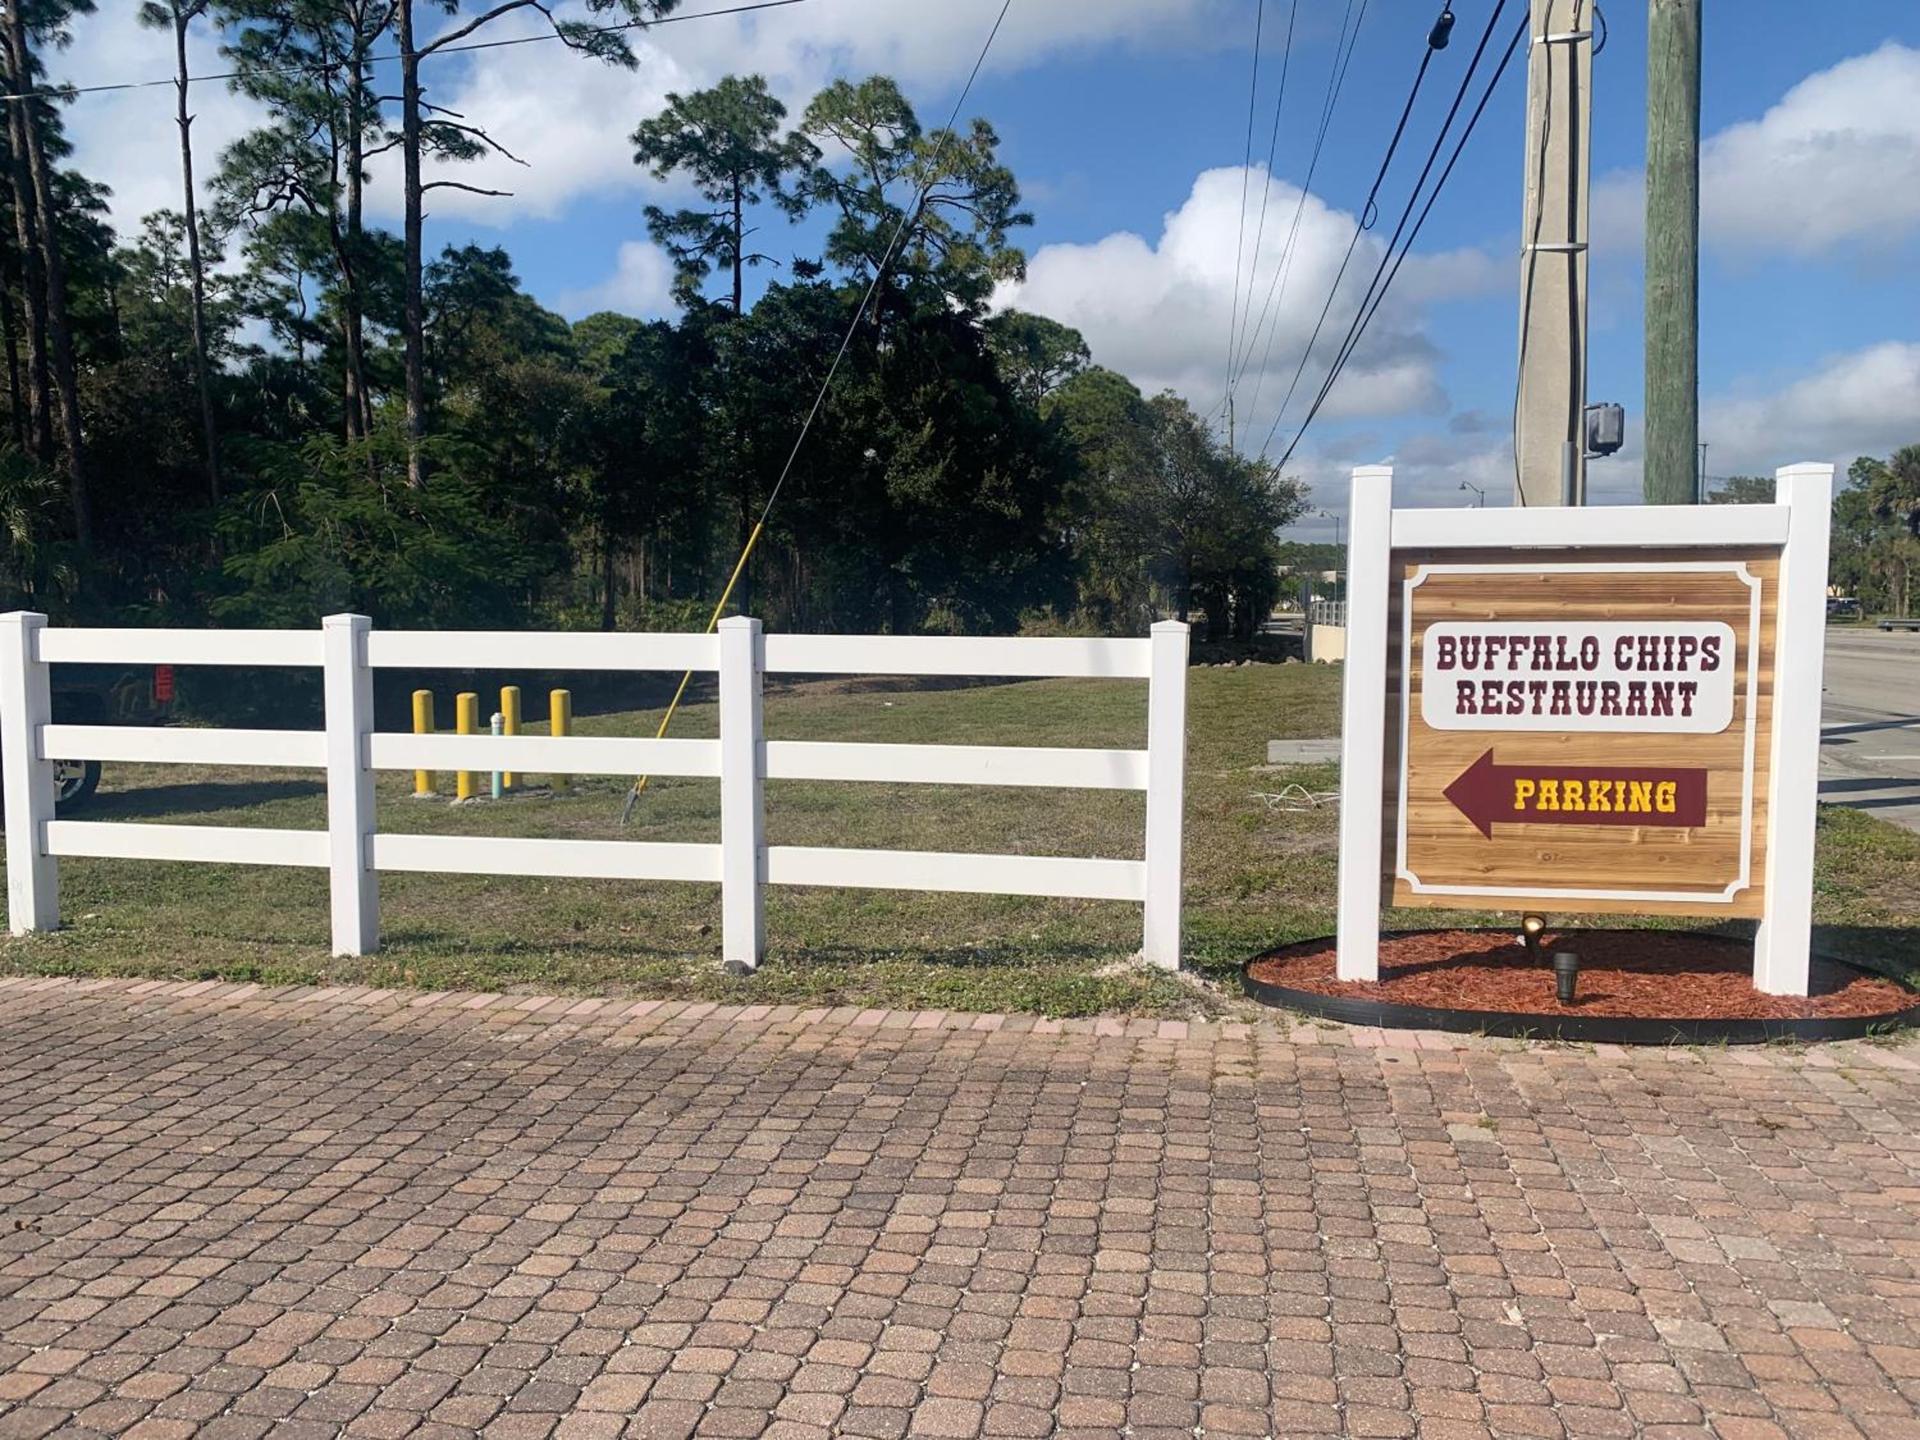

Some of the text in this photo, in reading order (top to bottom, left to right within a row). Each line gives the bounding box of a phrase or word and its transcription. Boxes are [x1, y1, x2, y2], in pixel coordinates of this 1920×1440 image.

[1437, 635, 1721, 671] BUFFALO CHIPS
[1456, 680, 1698, 717] RESTAURANT
[1514, 779, 1677, 812] PARKING
